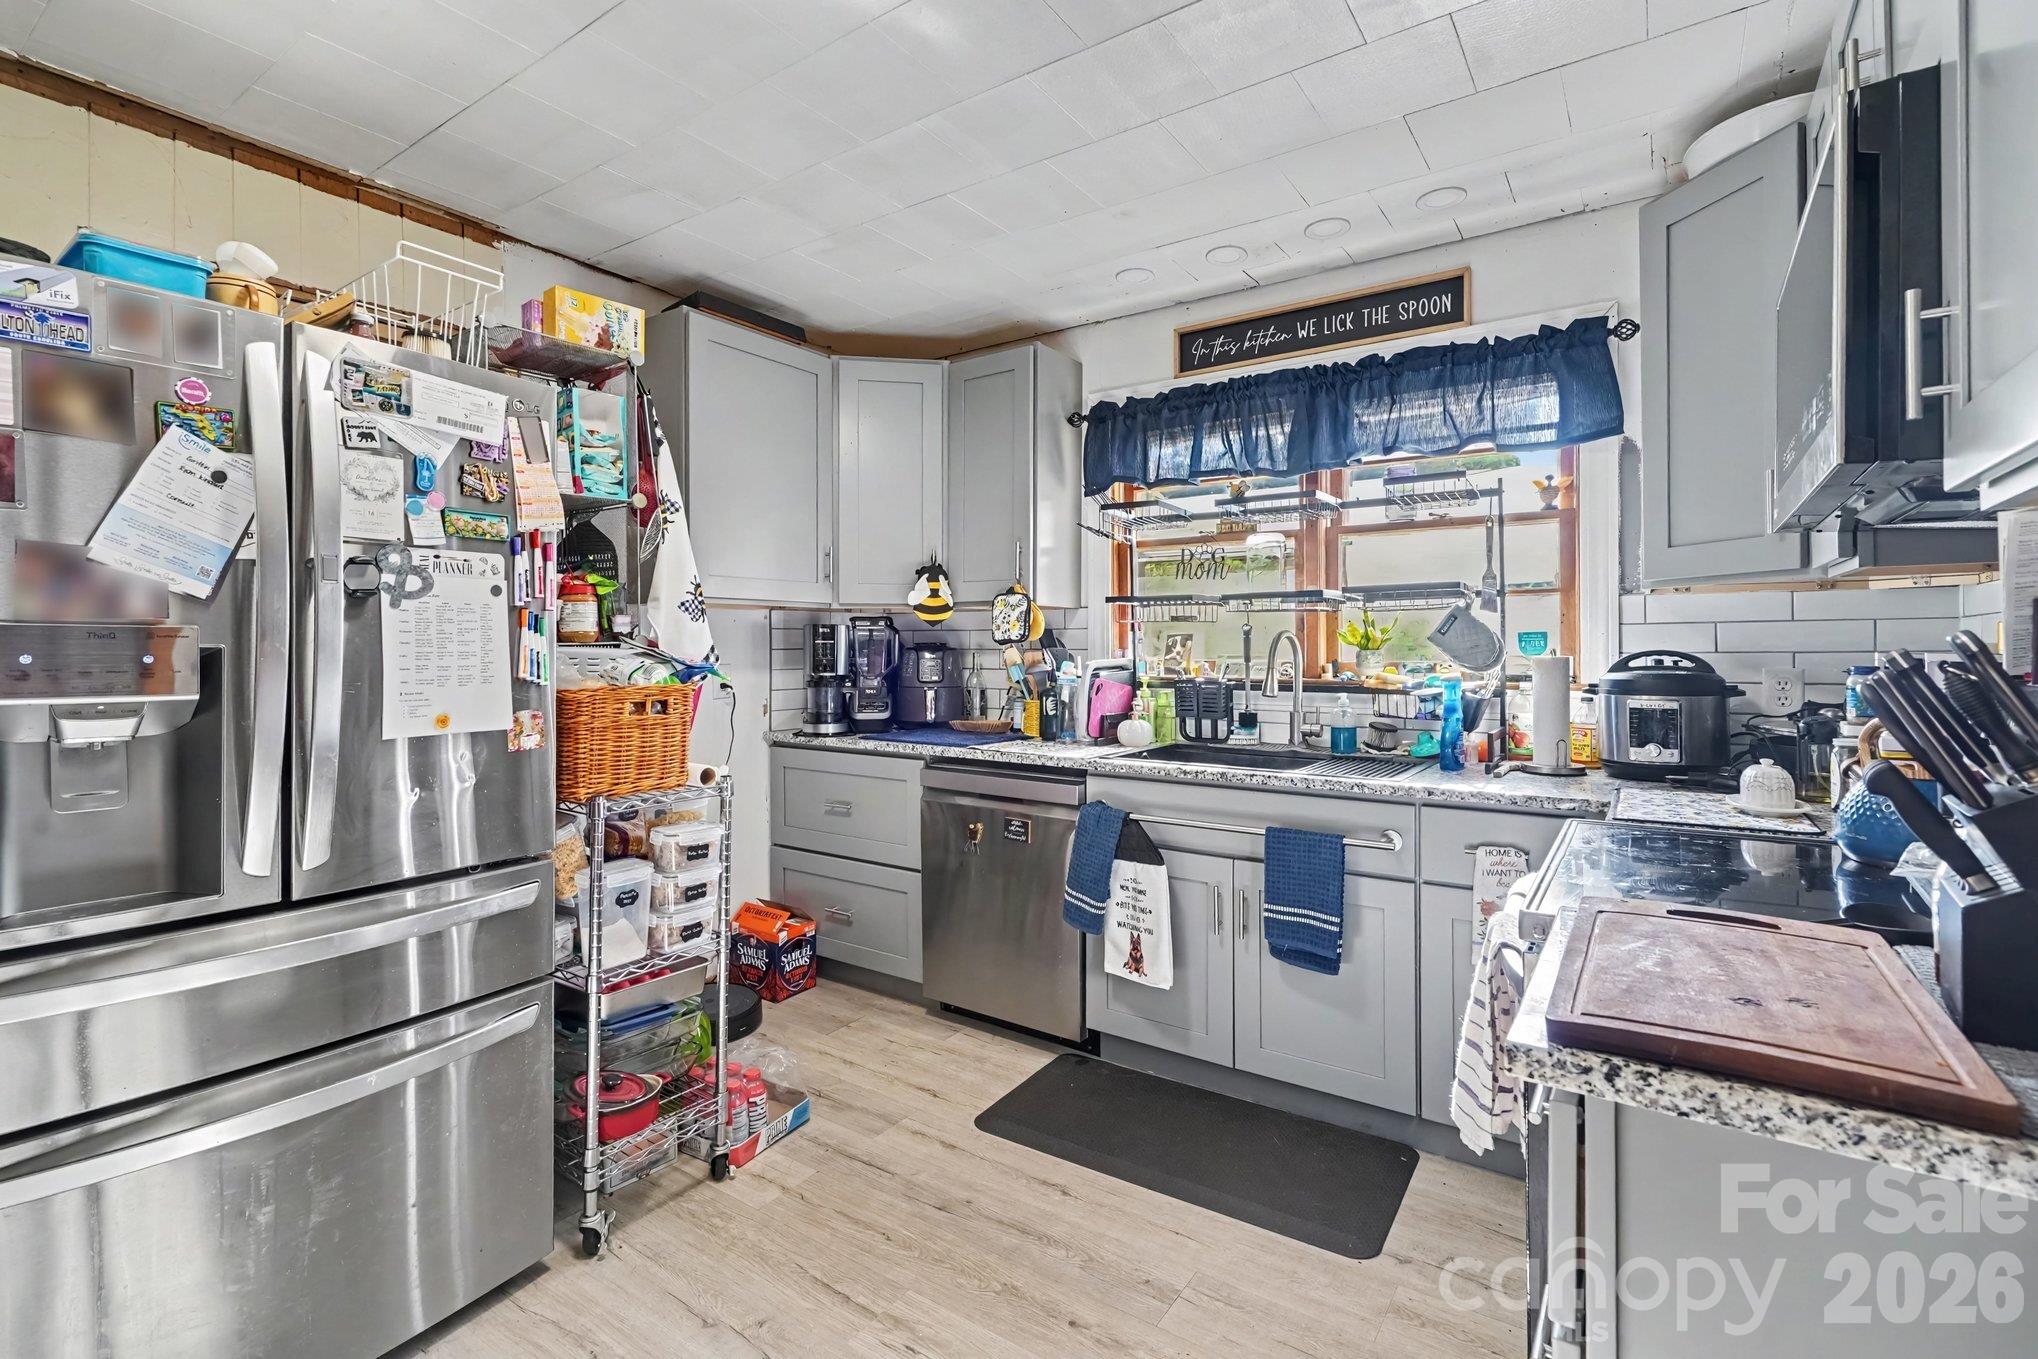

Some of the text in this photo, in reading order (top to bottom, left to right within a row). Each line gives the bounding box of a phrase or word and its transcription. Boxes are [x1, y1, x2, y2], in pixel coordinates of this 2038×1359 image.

[49, 289, 71, 301] iFix
[48, 322, 84, 342] HEAD
[1191, 293, 1452, 365] In this kitchen WE LICK THE SPOON
[526, 402, 540, 415] LG
[433, 560, 473, 576] PLANNER
[86, 632, 116, 640] ThinQ
[1485, 849, 1511, 857] HOME
[1490, 857, 1518, 867] where
[1486, 869, 1511, 877] WANT
[1514, 869, 1526, 878] TO
[737, 943, 769, 962] SAMUEL
[780, 944, 812, 965] SAMUEL
[739, 955, 766, 971] ADAMS
[783, 955, 810, 974] ADAMS
[765, 1115, 788, 1143] PRIME
